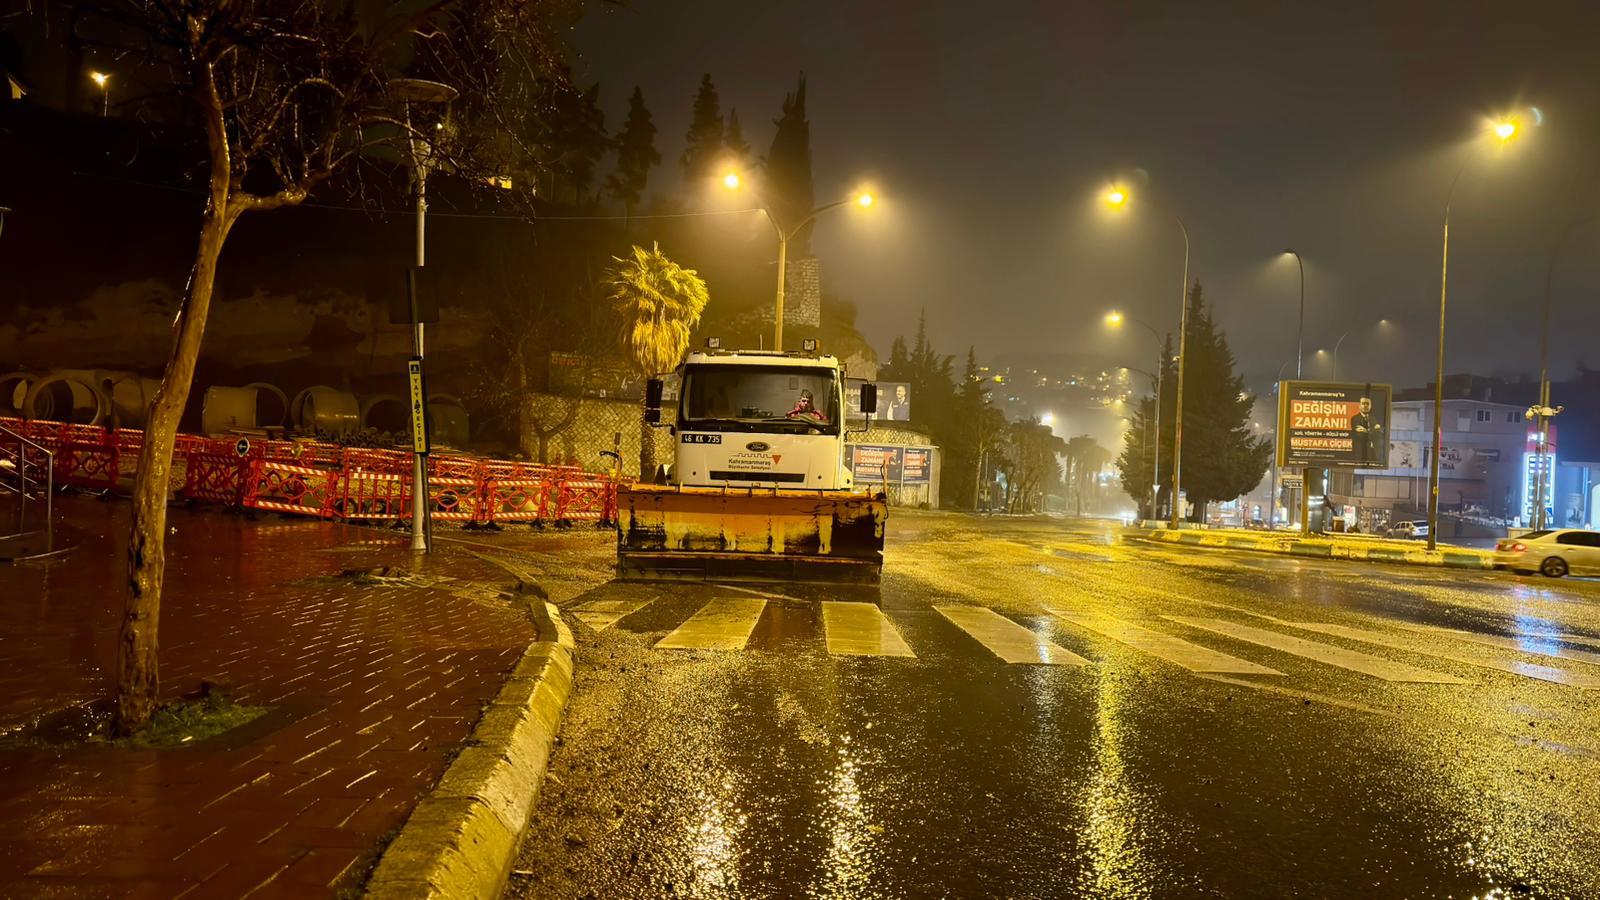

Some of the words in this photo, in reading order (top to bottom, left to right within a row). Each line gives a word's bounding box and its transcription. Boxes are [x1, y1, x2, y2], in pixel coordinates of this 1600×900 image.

[1294, 400, 1347, 417] DEĞİŞİM
[1295, 416, 1347, 429] ZAMANI!
[695, 435, 704, 443] KK
[707, 435, 720, 443] 735
[1291, 439, 1328, 447] MUSTAFA
[1329, 439, 1353, 448] ÇİÇEK
[728, 458, 771, 466] Kahramanmaraş
